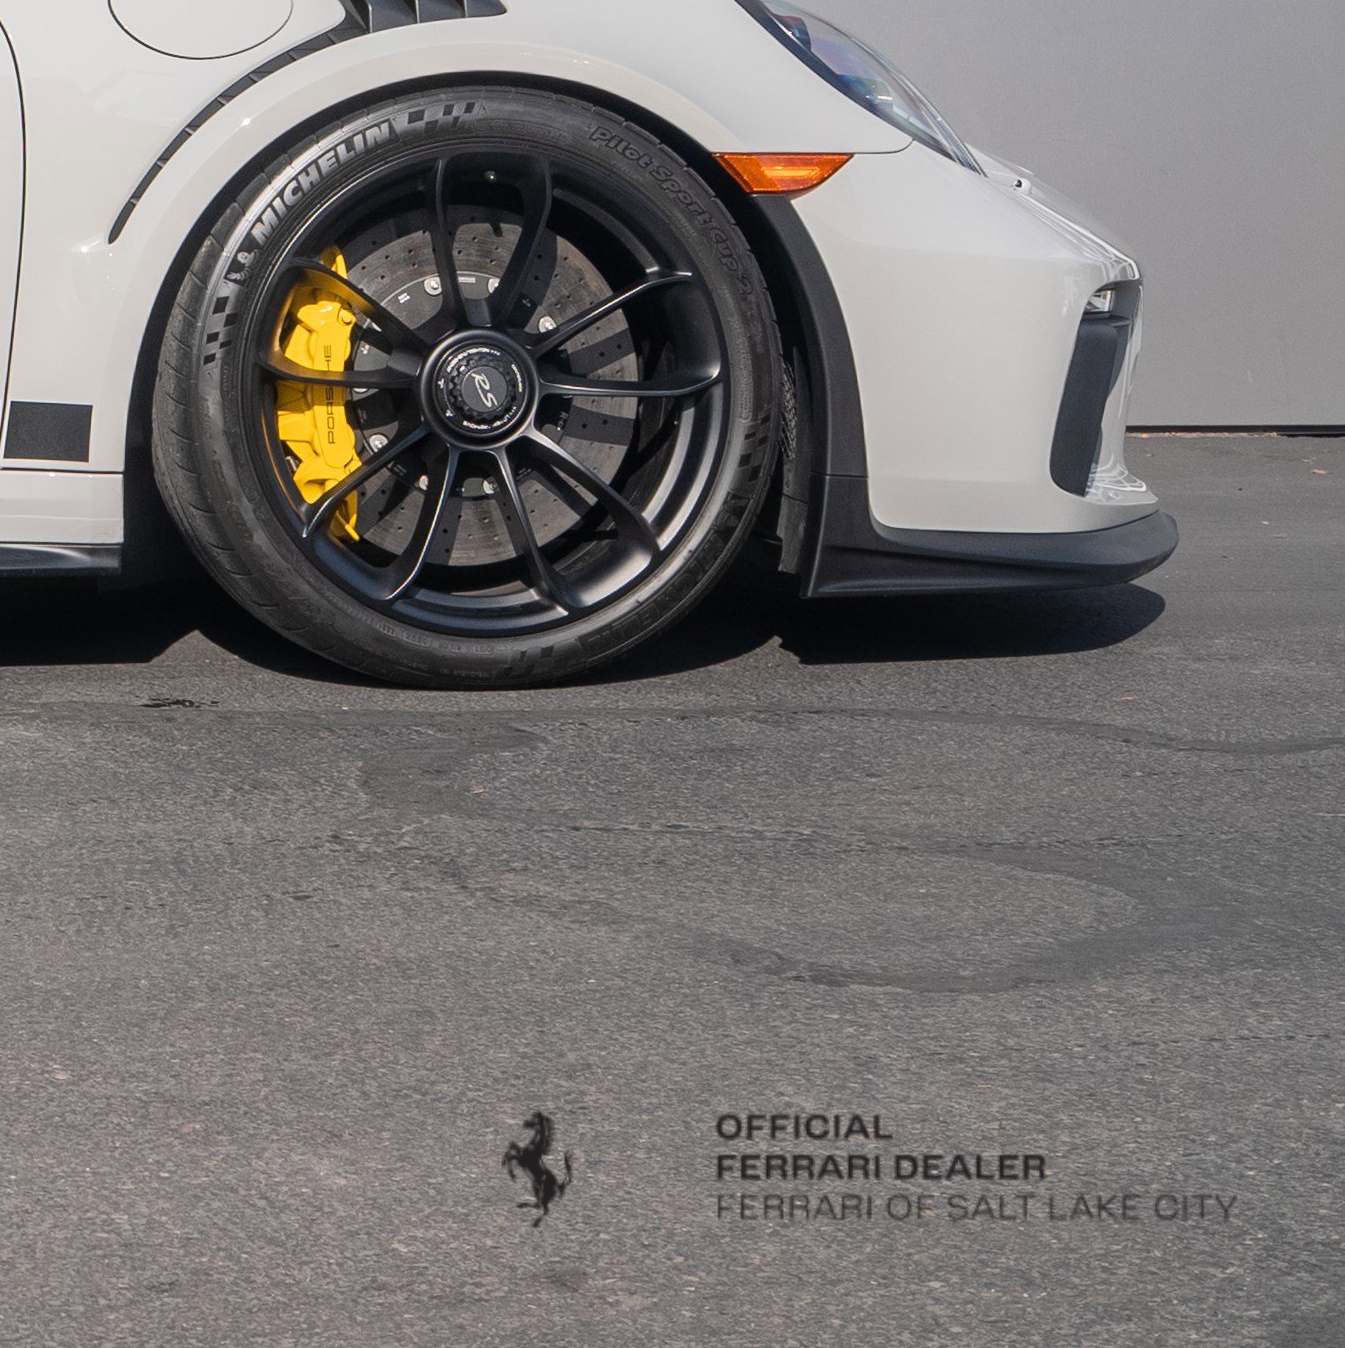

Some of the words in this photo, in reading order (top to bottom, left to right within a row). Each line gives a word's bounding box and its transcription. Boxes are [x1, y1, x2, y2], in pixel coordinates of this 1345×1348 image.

[250, 121, 391, 247] MICHELIN
[590, 126, 654, 169] Pilot
[649, 164, 713, 227] Sport
[710, 227, 740, 272] Cup
[323, 344, 336, 445] PORSHE
